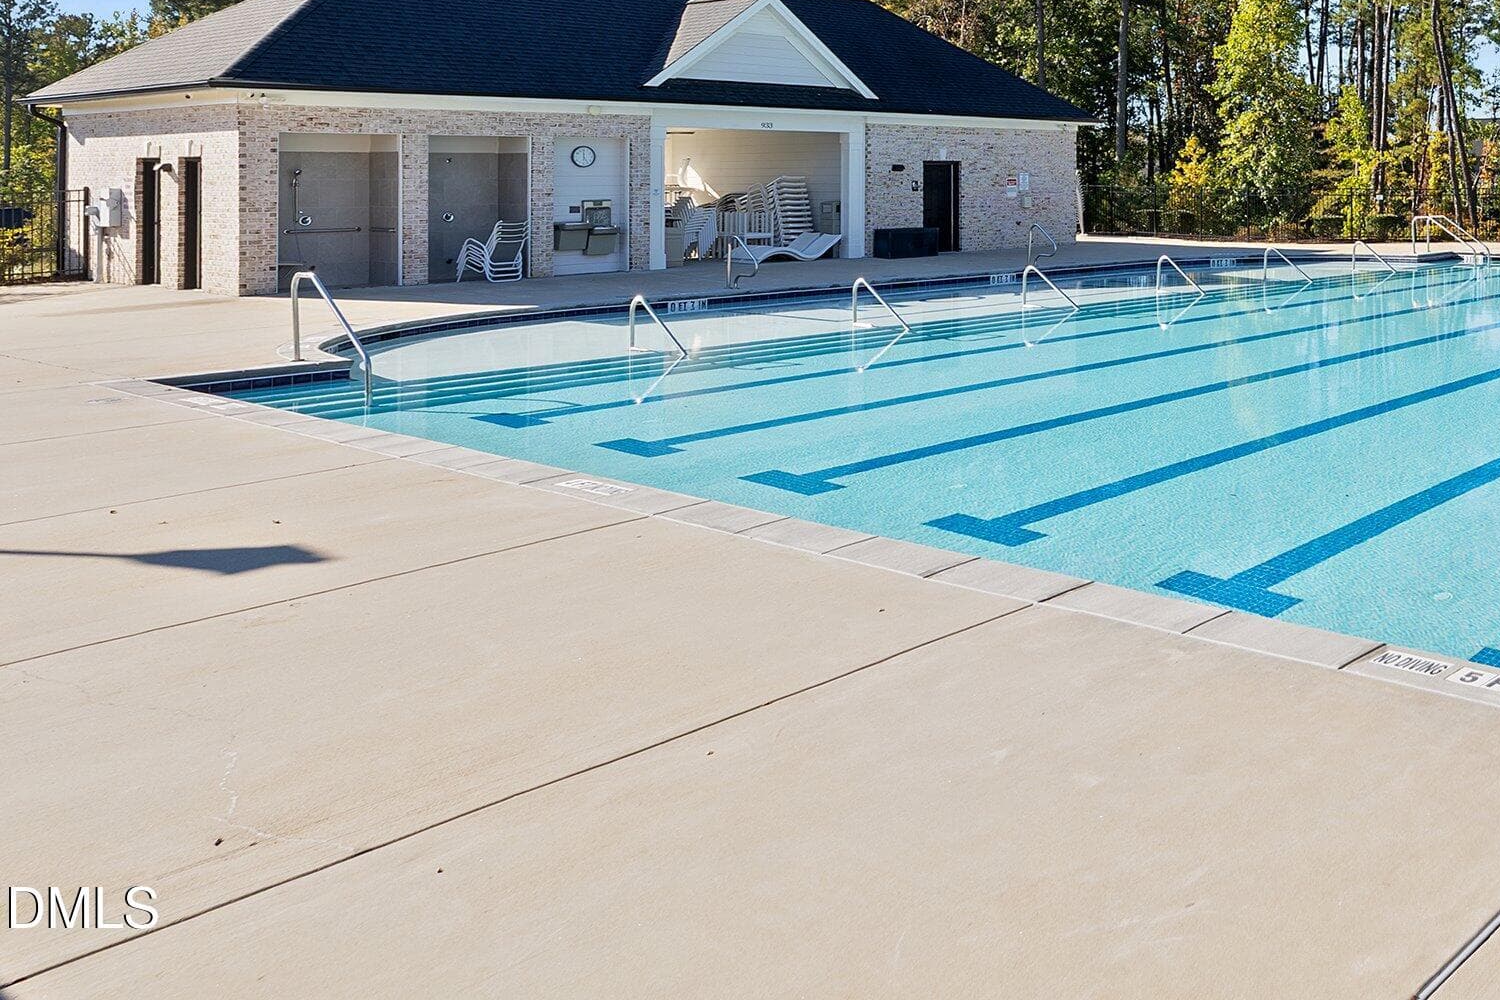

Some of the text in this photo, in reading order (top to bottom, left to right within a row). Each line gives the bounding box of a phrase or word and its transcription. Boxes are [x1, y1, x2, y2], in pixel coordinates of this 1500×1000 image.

[1374, 652, 1400, 664] NO
[1395, 657, 1448, 676] DIVING
[1459, 671, 1483, 683] 5
